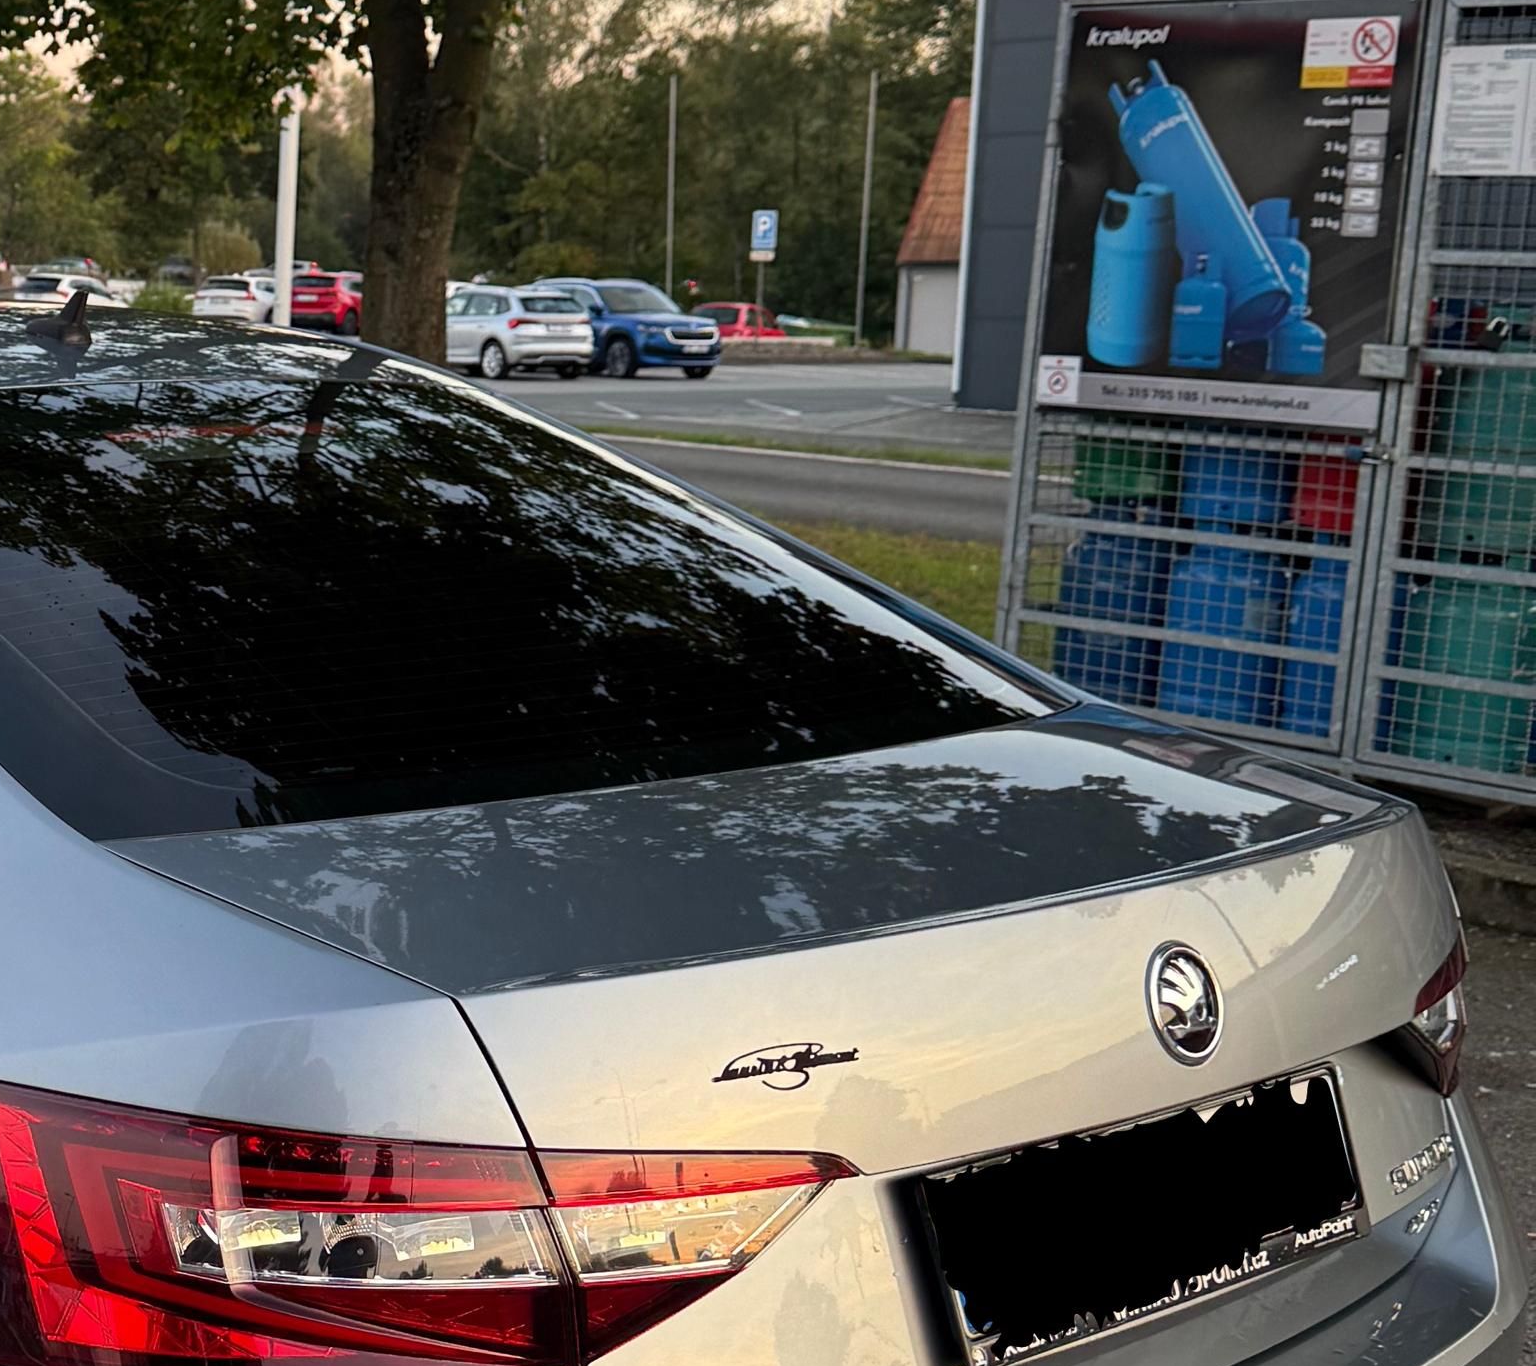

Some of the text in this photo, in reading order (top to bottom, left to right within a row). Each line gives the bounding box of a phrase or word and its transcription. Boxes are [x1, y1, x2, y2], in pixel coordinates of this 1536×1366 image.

[1086, 24, 1170, 50] kralupol
[757, 216, 771, 236] P
[1294, 1214, 1354, 1248] AutoPoint
